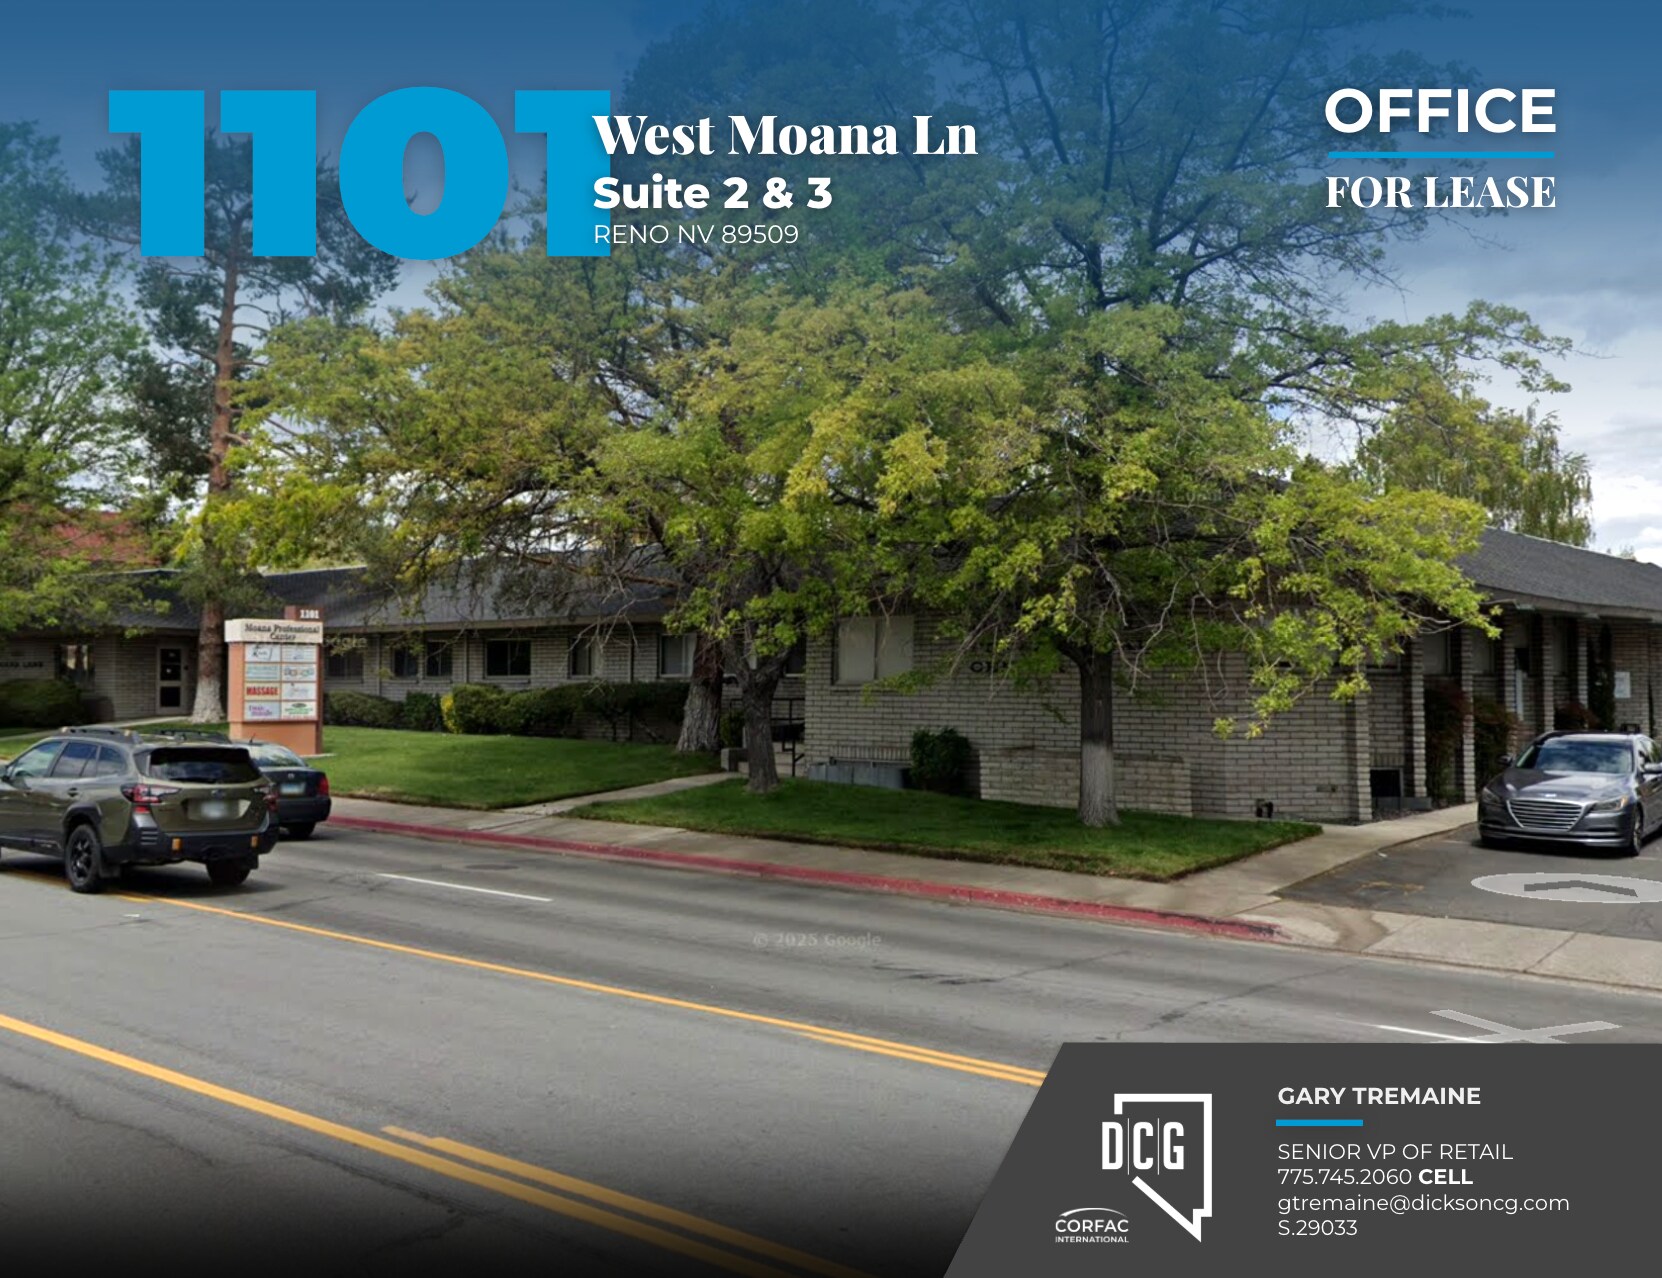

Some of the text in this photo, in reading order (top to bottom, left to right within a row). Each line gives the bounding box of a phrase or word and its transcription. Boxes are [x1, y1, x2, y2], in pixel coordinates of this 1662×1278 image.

[244, 623, 321, 634] Moana Professional
[269, 632, 296, 641] Center
[246, 686, 279, 696] MASSAGE
